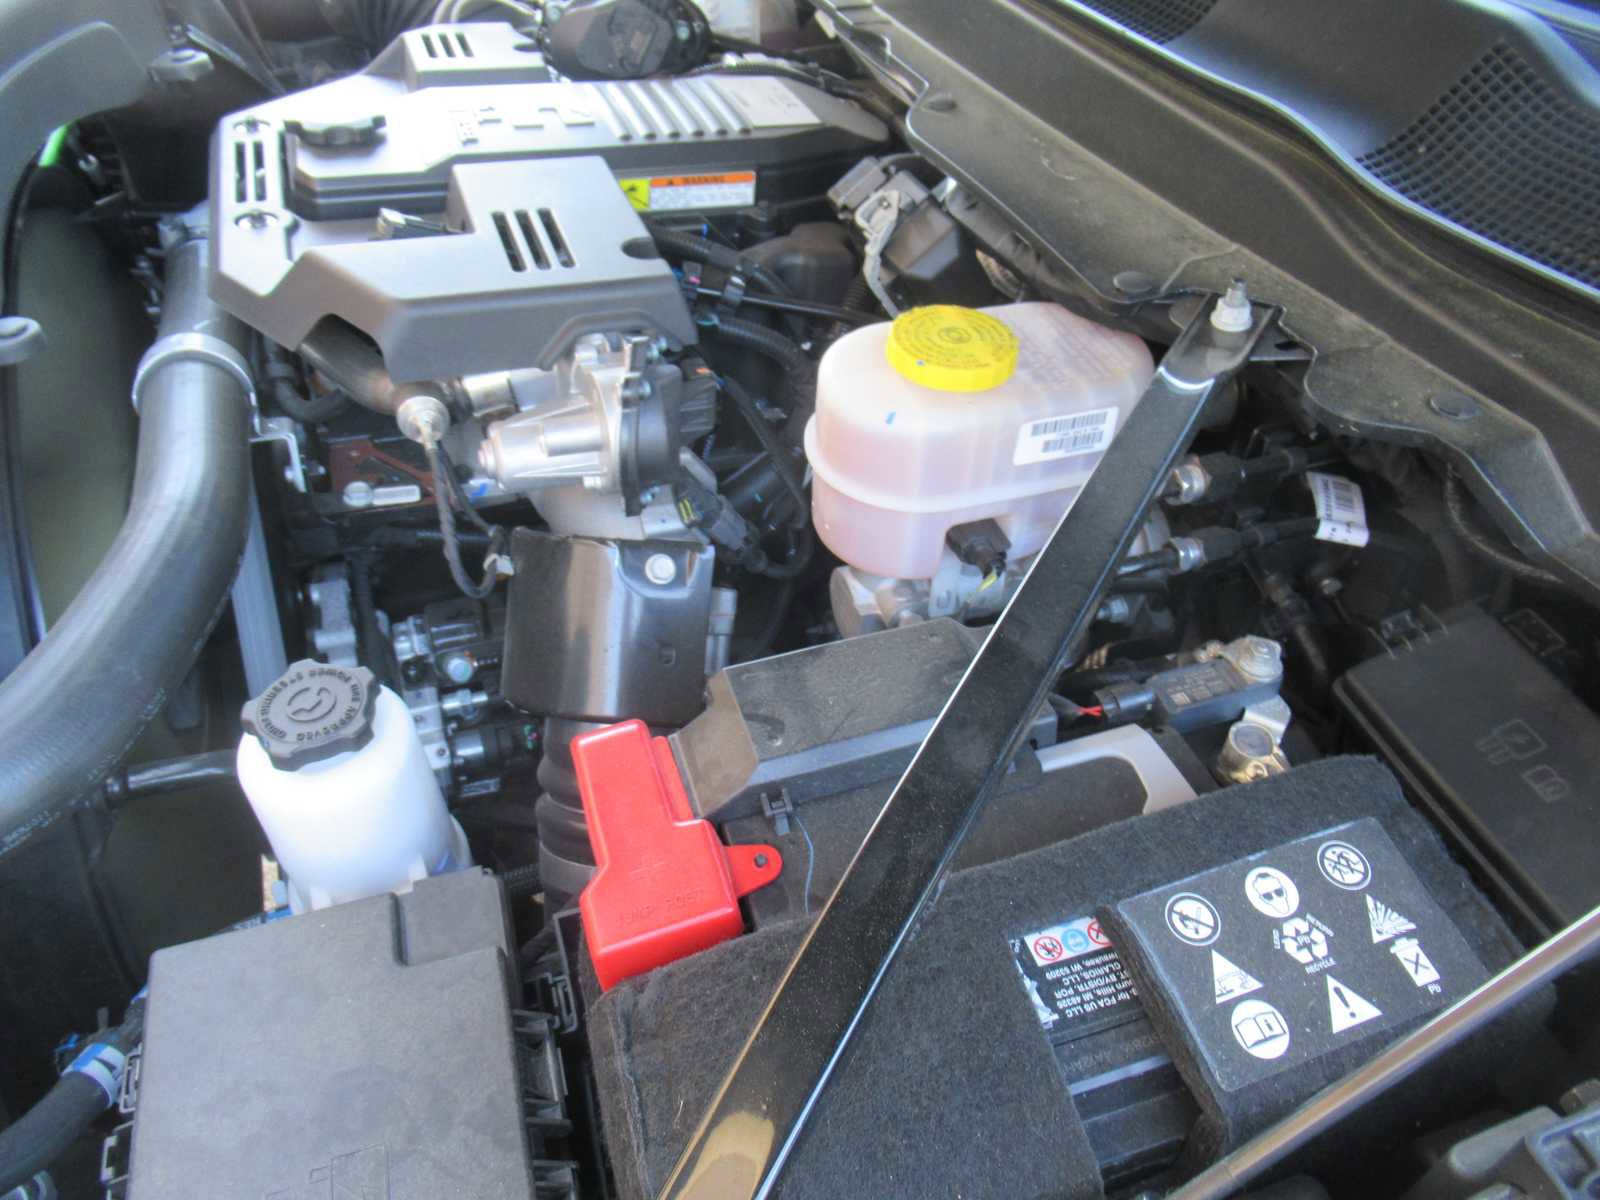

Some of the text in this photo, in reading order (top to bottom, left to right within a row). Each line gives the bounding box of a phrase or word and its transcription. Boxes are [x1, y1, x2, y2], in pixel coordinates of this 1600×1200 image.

[1062, 973, 1081, 986] LLC
[1053, 986, 1075, 999] POR
[1098, 994, 1119, 1007] FCA
[1065, 1005, 1083, 1018] LLC
